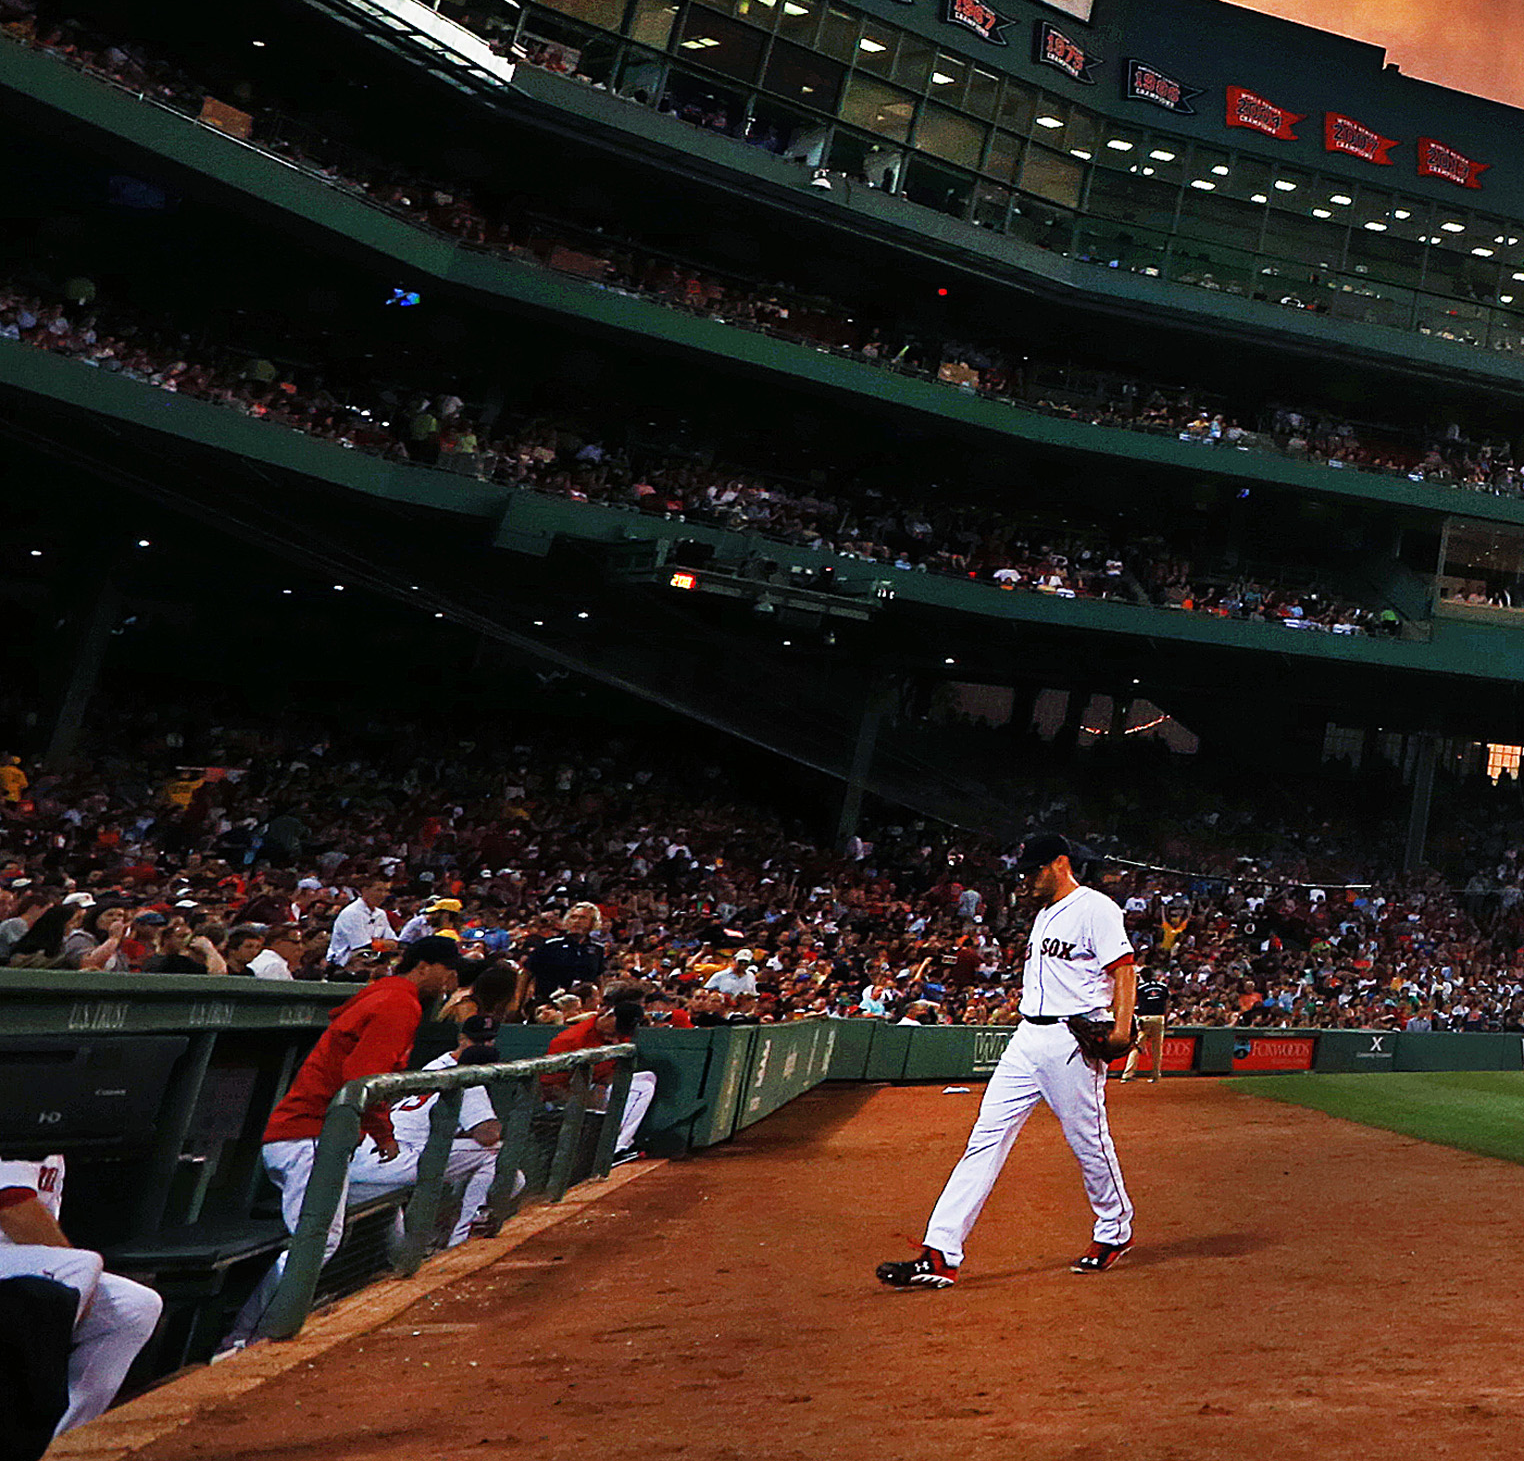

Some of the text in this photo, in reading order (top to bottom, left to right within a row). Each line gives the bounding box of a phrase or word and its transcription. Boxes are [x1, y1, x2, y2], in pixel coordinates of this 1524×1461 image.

[1333, 123, 1380, 155] 2007
[1041, 937, 1077, 961] SOX
[1251, 1041, 1311, 1058] FOXWOODS
[1369, 1036, 1384, 1052] X
